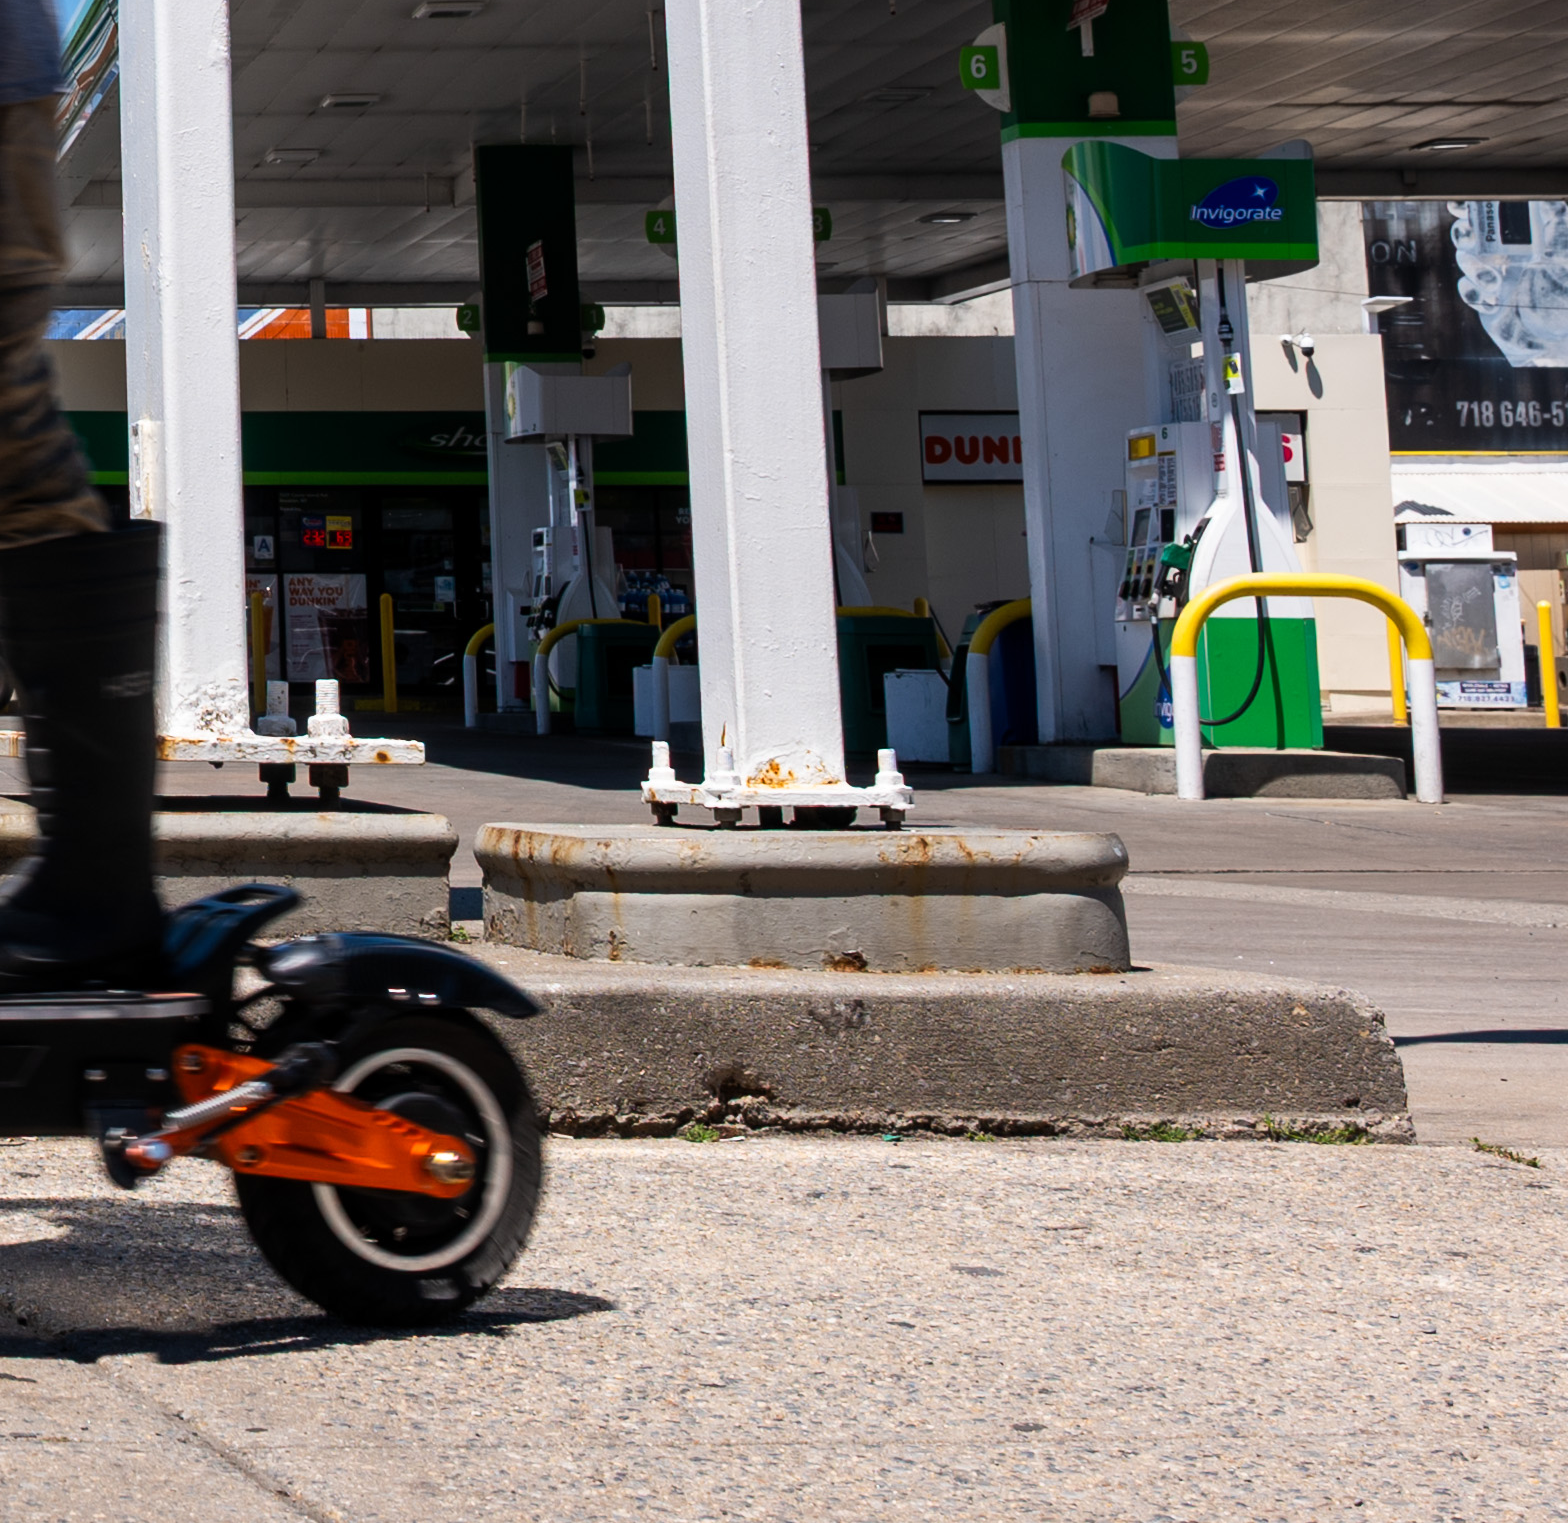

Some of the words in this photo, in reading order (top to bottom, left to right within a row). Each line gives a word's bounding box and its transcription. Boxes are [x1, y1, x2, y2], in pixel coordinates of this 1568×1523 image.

[970, 54, 987, 79] 6
[1181, 50, 1197, 74] 5
[1190, 204, 1284, 224] Invigorate
[652, 218, 666, 235] 4
[462, 310, 472, 325] 2
[1456, 401, 1493, 426] 718
[1161, 427, 1168, 439] 6
[258, 539, 271, 552] A
[289, 578, 313, 586] ANY
[289, 587, 316, 596] WAY
[318, 587, 343, 596] YOU
[289, 597, 339, 606] DUNKIN'
